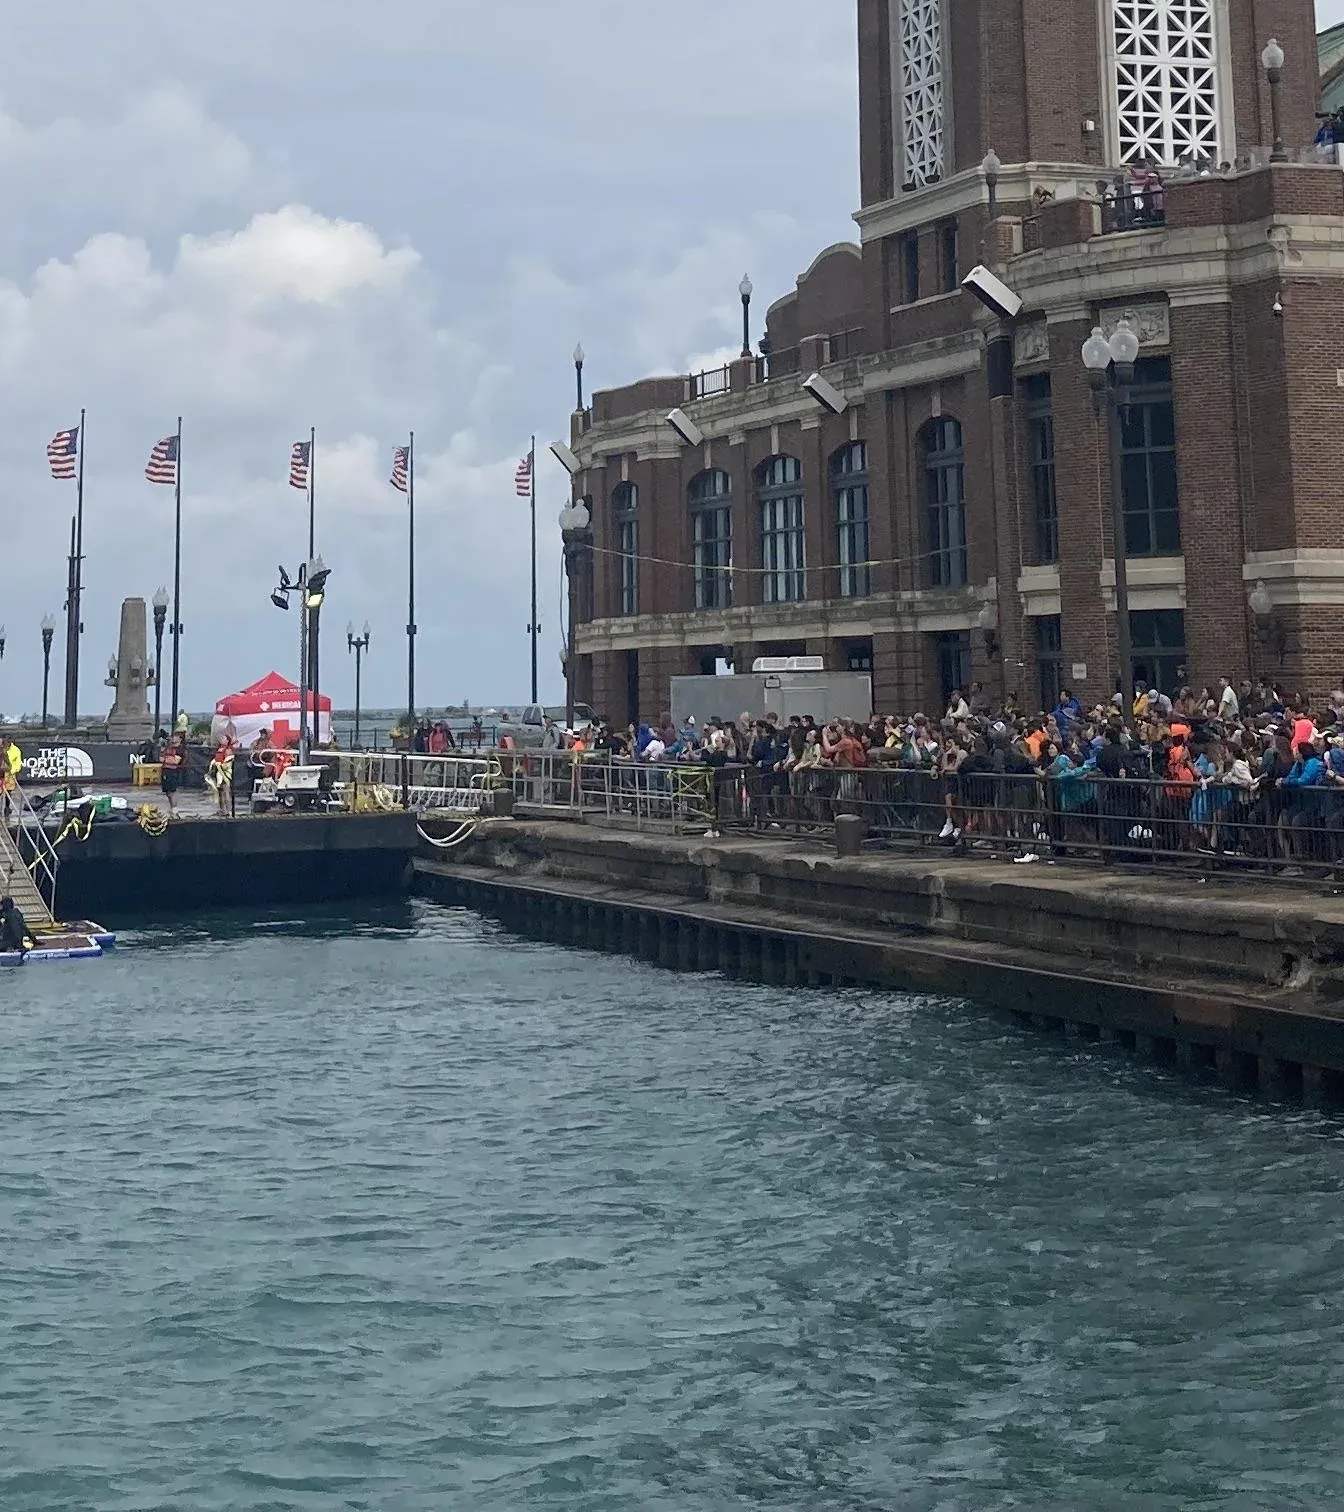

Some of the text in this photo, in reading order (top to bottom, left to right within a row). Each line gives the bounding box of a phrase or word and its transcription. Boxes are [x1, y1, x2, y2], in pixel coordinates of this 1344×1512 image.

[39, 748, 67, 758] THE
[22, 756, 66, 768] NORTH
[30, 767, 66, 777] FACE
